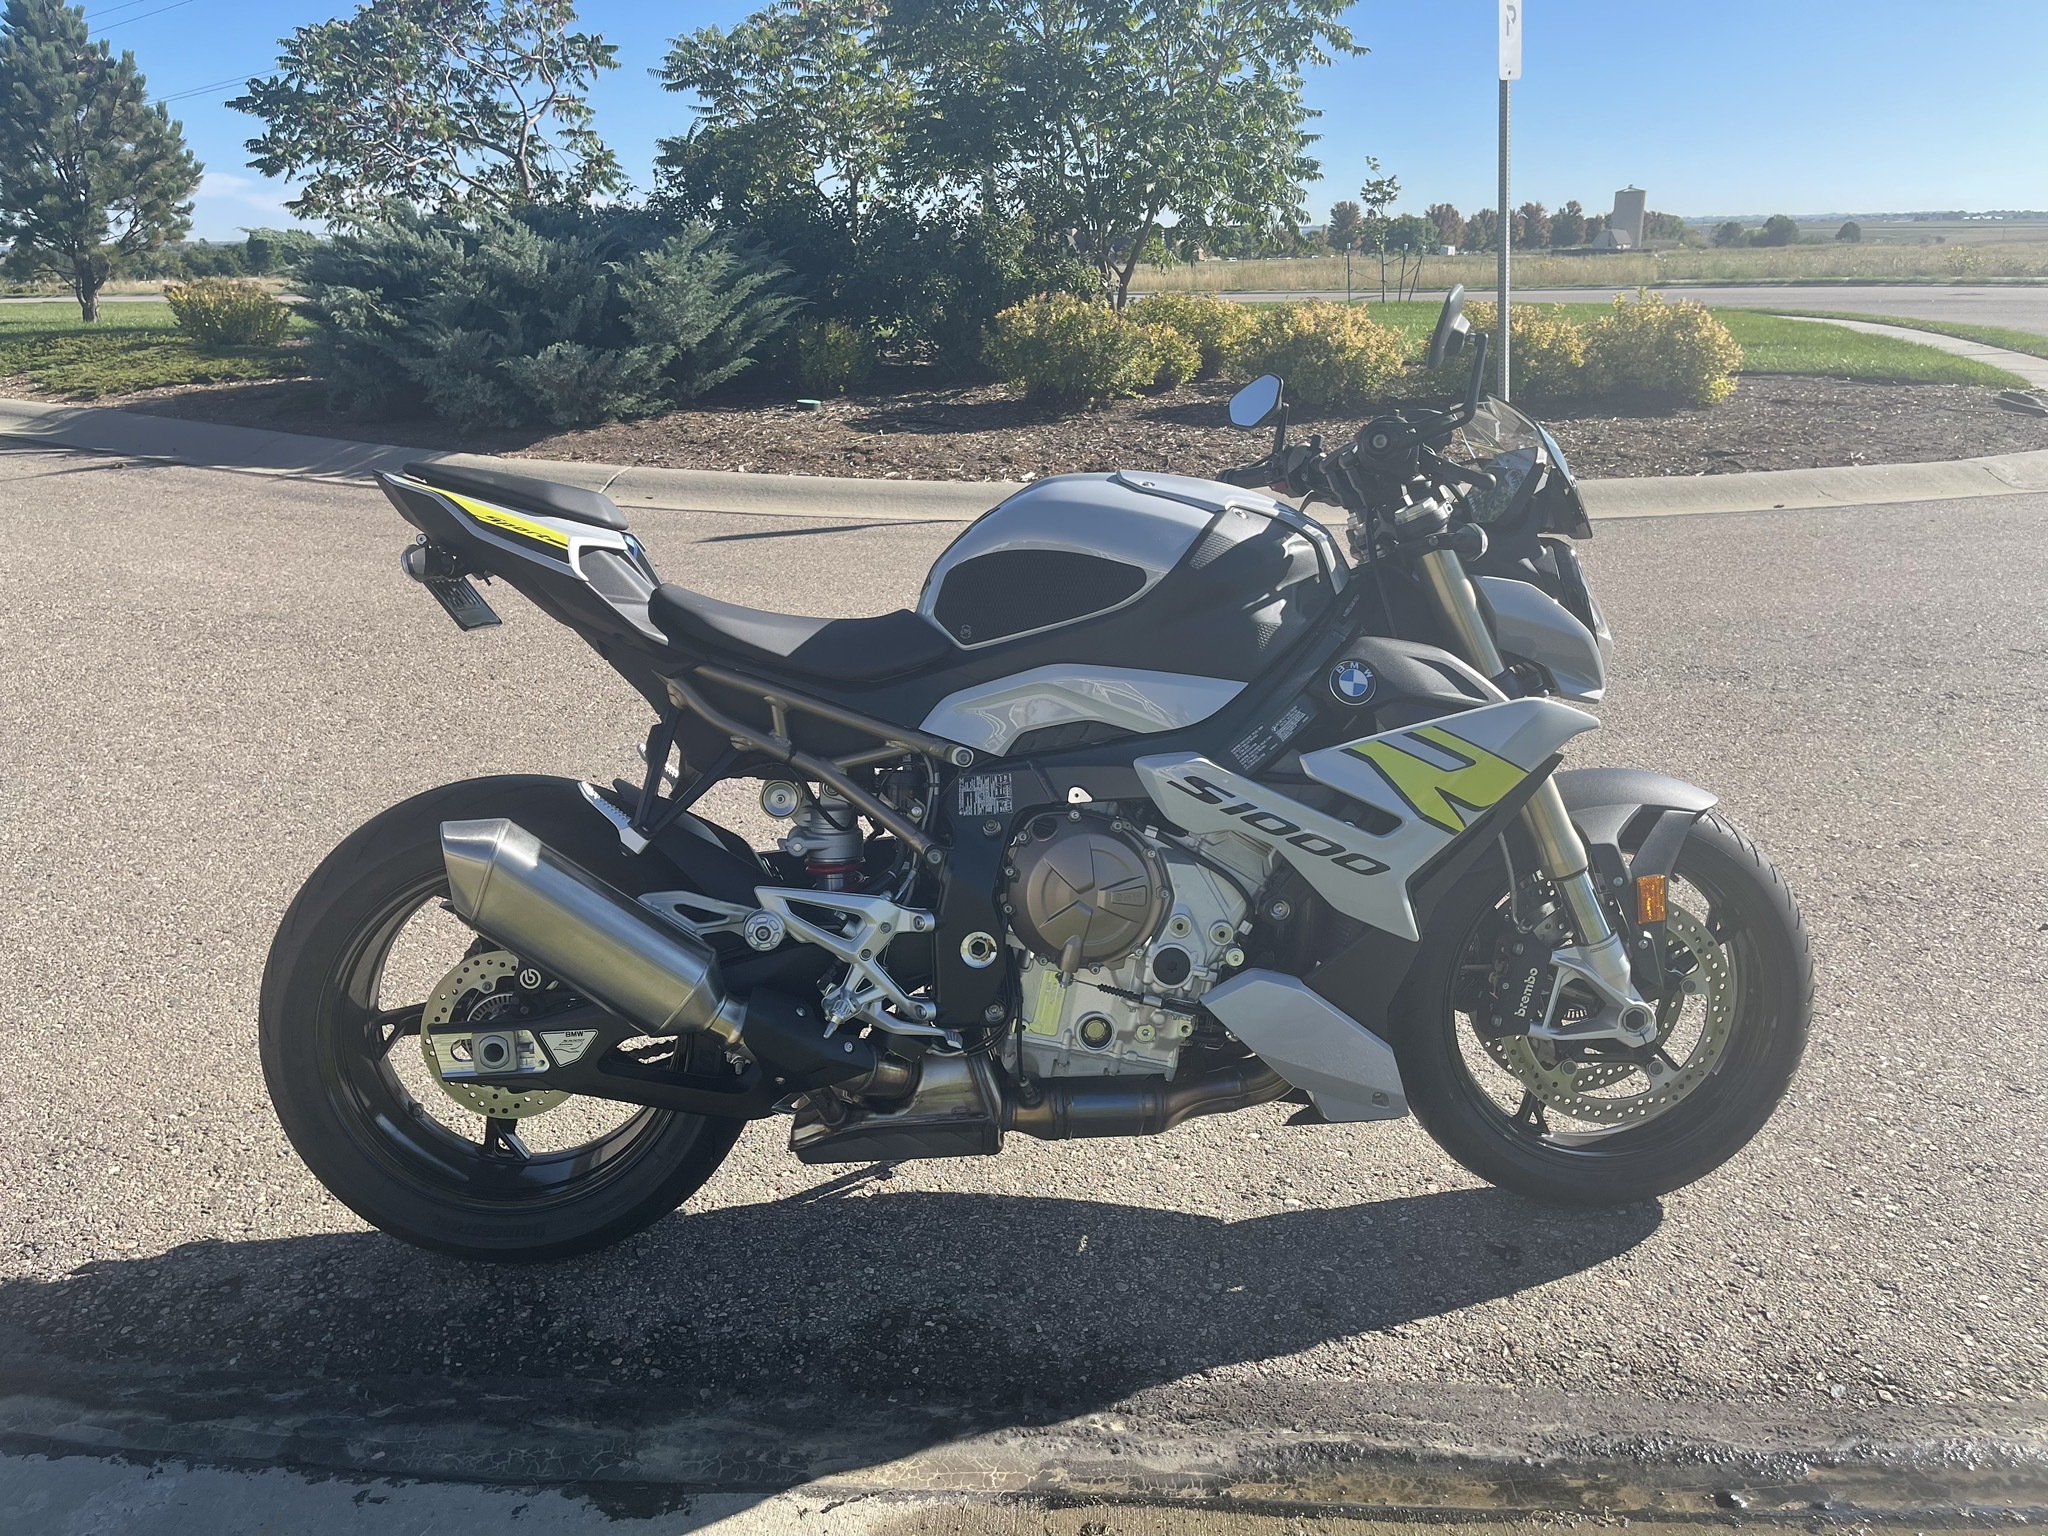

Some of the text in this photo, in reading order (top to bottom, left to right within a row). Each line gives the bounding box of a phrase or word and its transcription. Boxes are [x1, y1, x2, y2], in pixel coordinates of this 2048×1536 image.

[1335, 661, 1373, 678] BMW
[1166, 775, 1392, 876] S1000
[1514, 966, 1539, 1018] brembo
